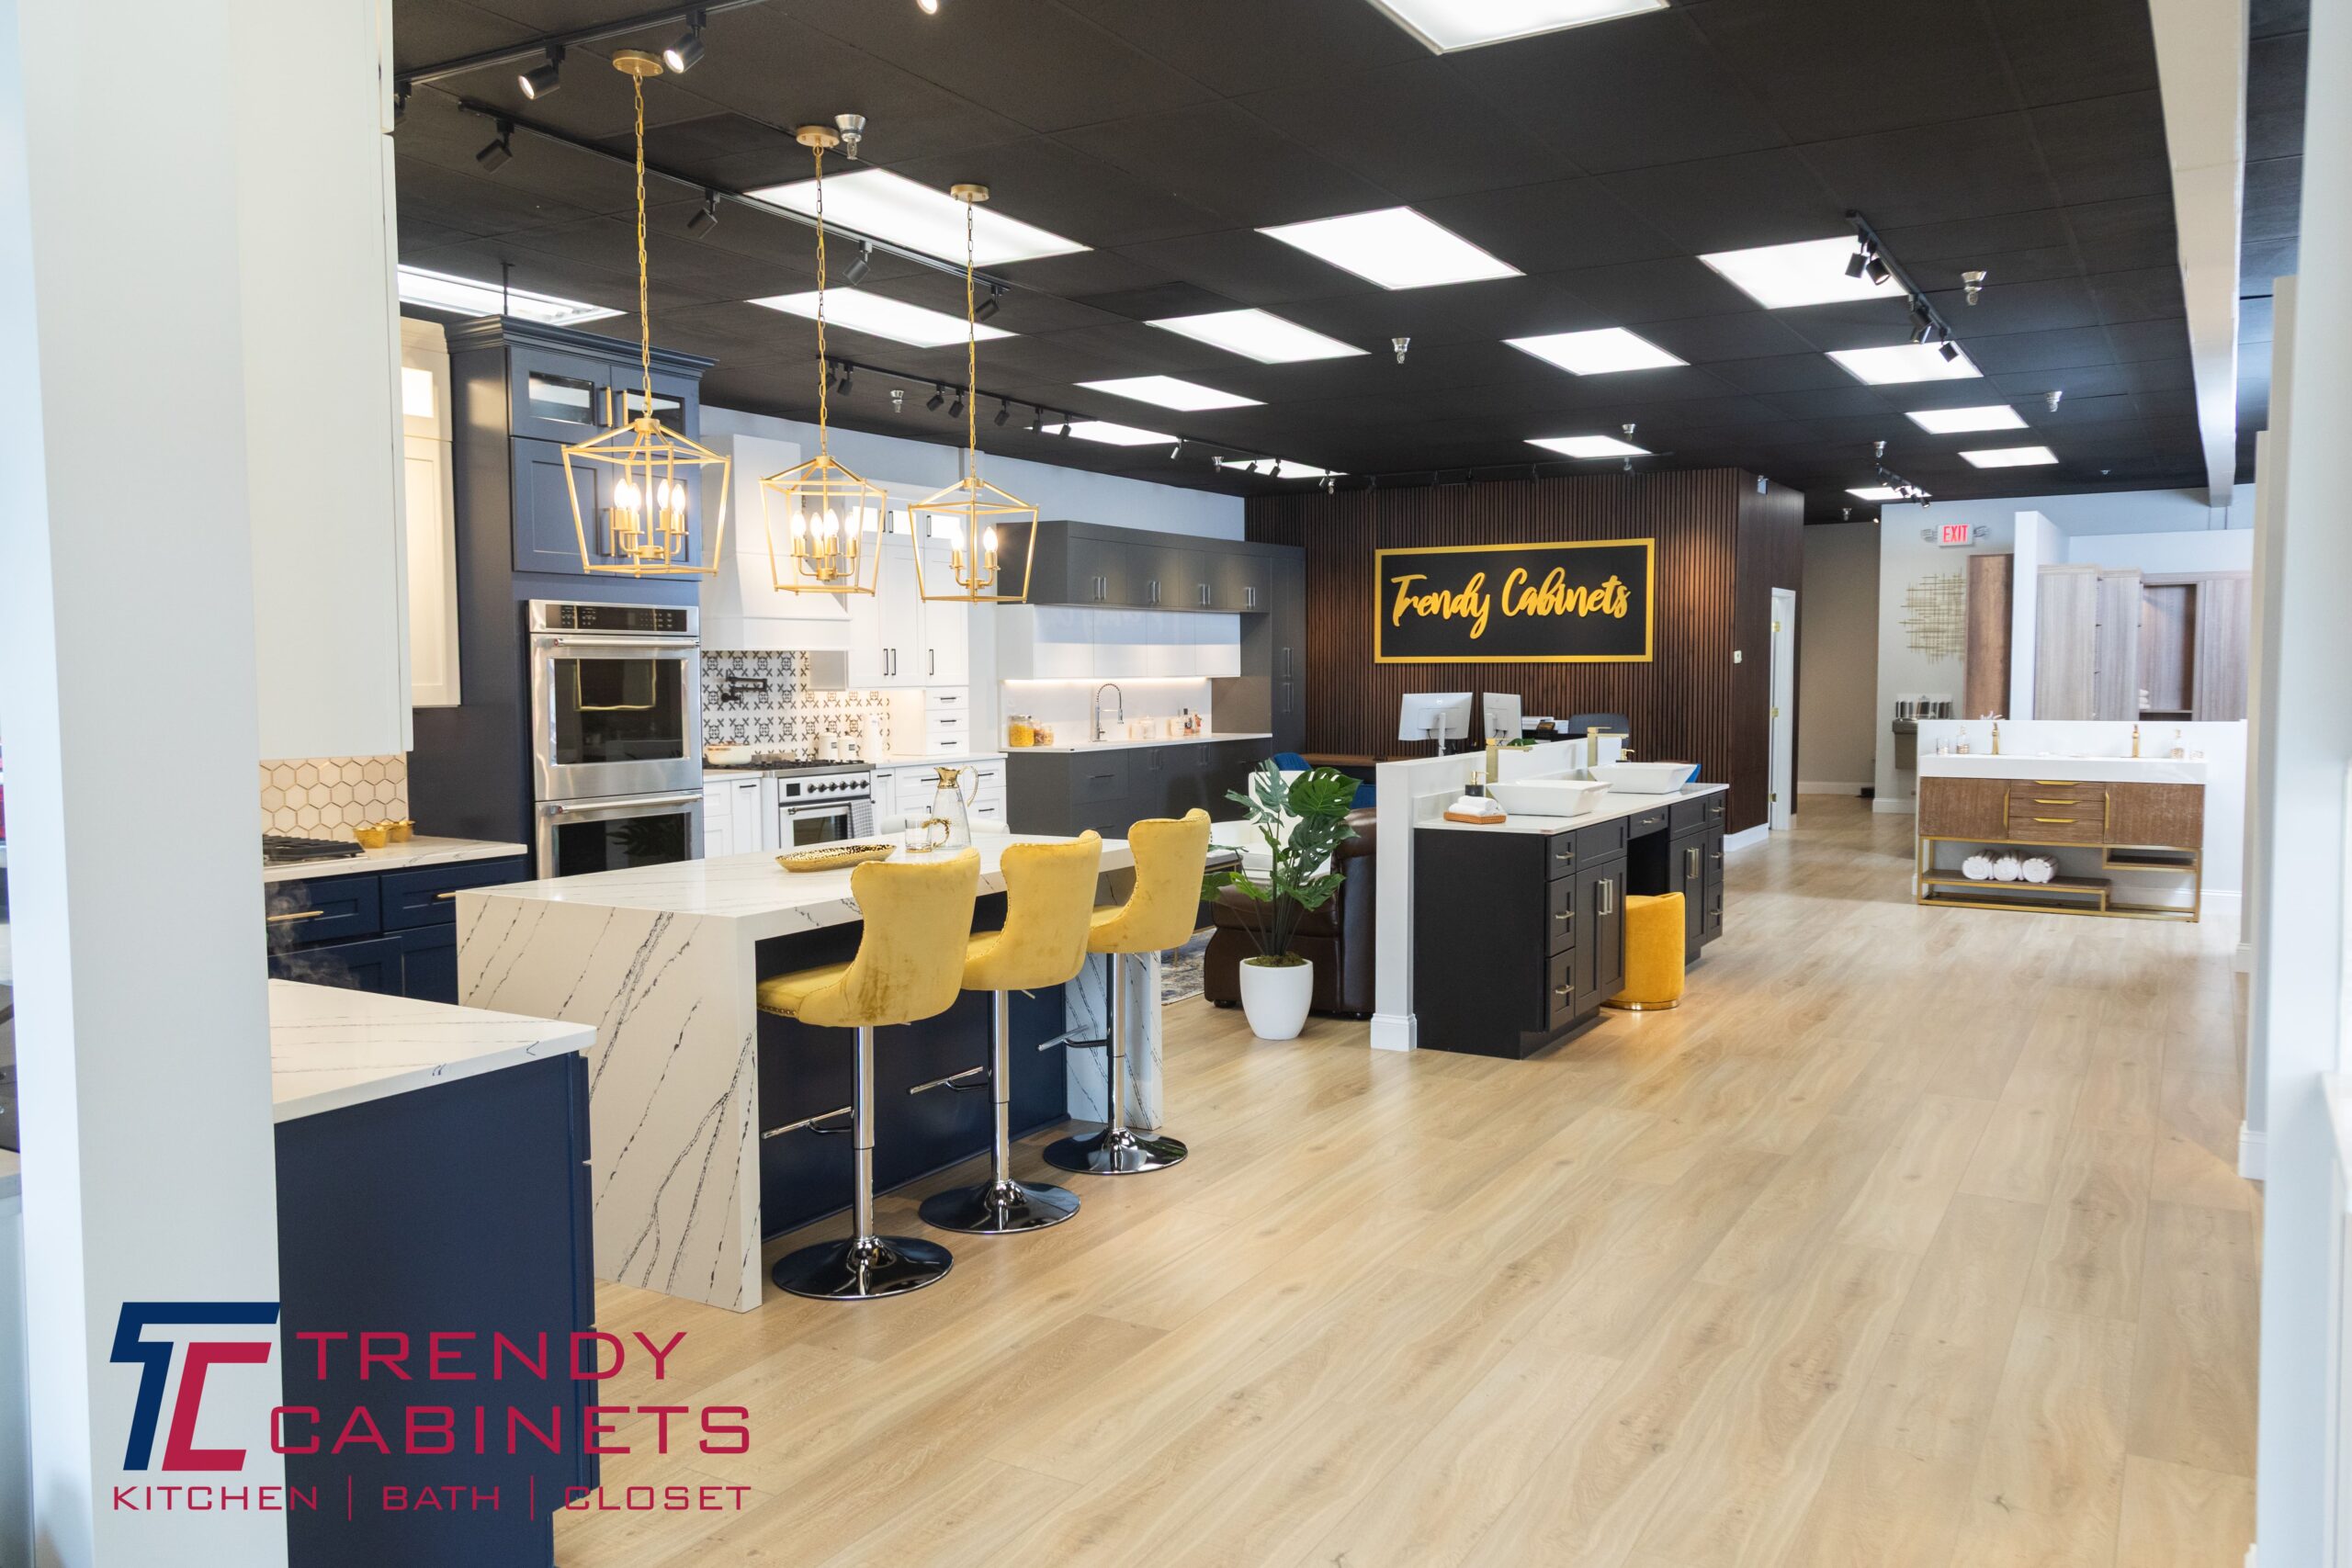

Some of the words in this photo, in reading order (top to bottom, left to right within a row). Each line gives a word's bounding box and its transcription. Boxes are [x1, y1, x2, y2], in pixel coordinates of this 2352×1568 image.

[1942, 524, 1969, 544] EXIT
[1390, 571, 1491, 640] Trendy
[1501, 566, 1632, 619] Cabinets
